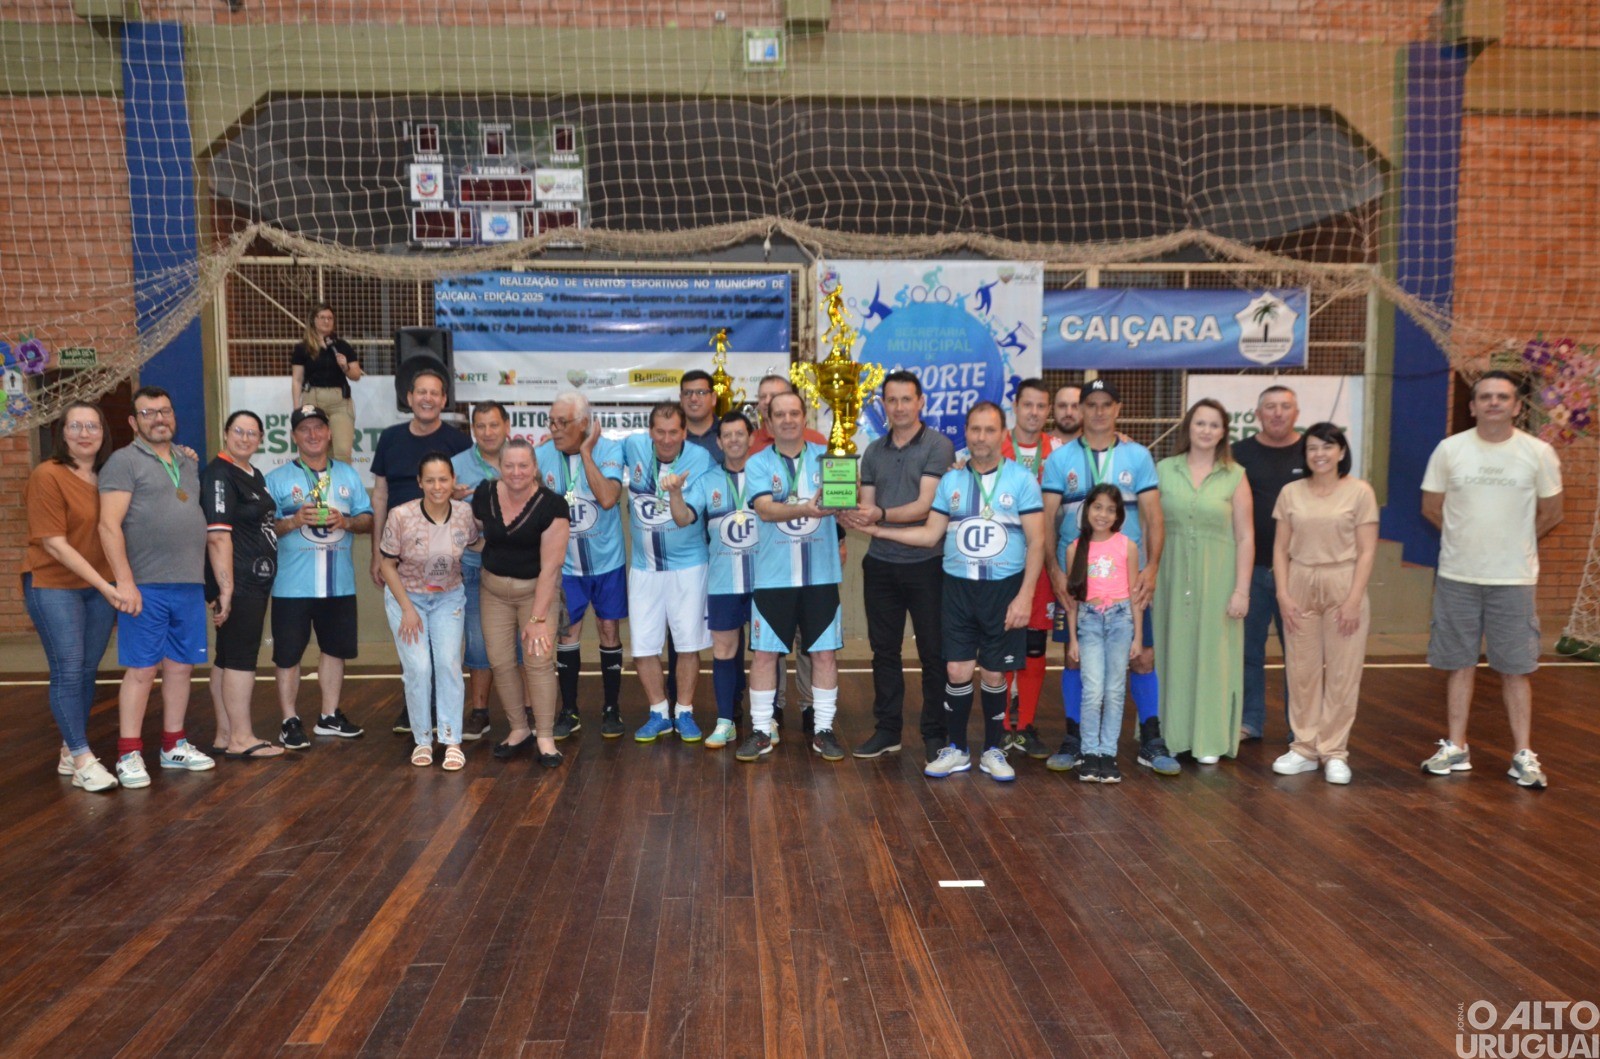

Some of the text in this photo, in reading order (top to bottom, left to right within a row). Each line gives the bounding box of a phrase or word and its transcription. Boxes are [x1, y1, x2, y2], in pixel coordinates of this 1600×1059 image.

[476, 166, 515, 175] TEMPO
[499, 275, 559, 289] REALIZAÇÃO
[564, 278, 577, 287] DE
[583, 278, 626, 288] EVENTOS
[631, 279, 689, 289] ESPORTIVOS
[694, 279, 710, 288] NO
[715, 277, 766, 289] MUNICÍPIO
[772, 279, 785, 289] DE
[435, 291, 477, 303] CAIÇARA
[483, 290, 520, 303] EDIÇÃO
[522, 292, 544, 302] 2025
[895, 328, 967, 337] SECRETARIA
[1059, 314, 1223, 347] CAIÇARA
[887, 338, 973, 352] MUNICIPAL
[1478, 466, 1505, 475] new
[1464, 474, 1517, 487] balance
[825, 488, 853, 496] CAMPEÃO
[963, 525, 996, 552] CLF
